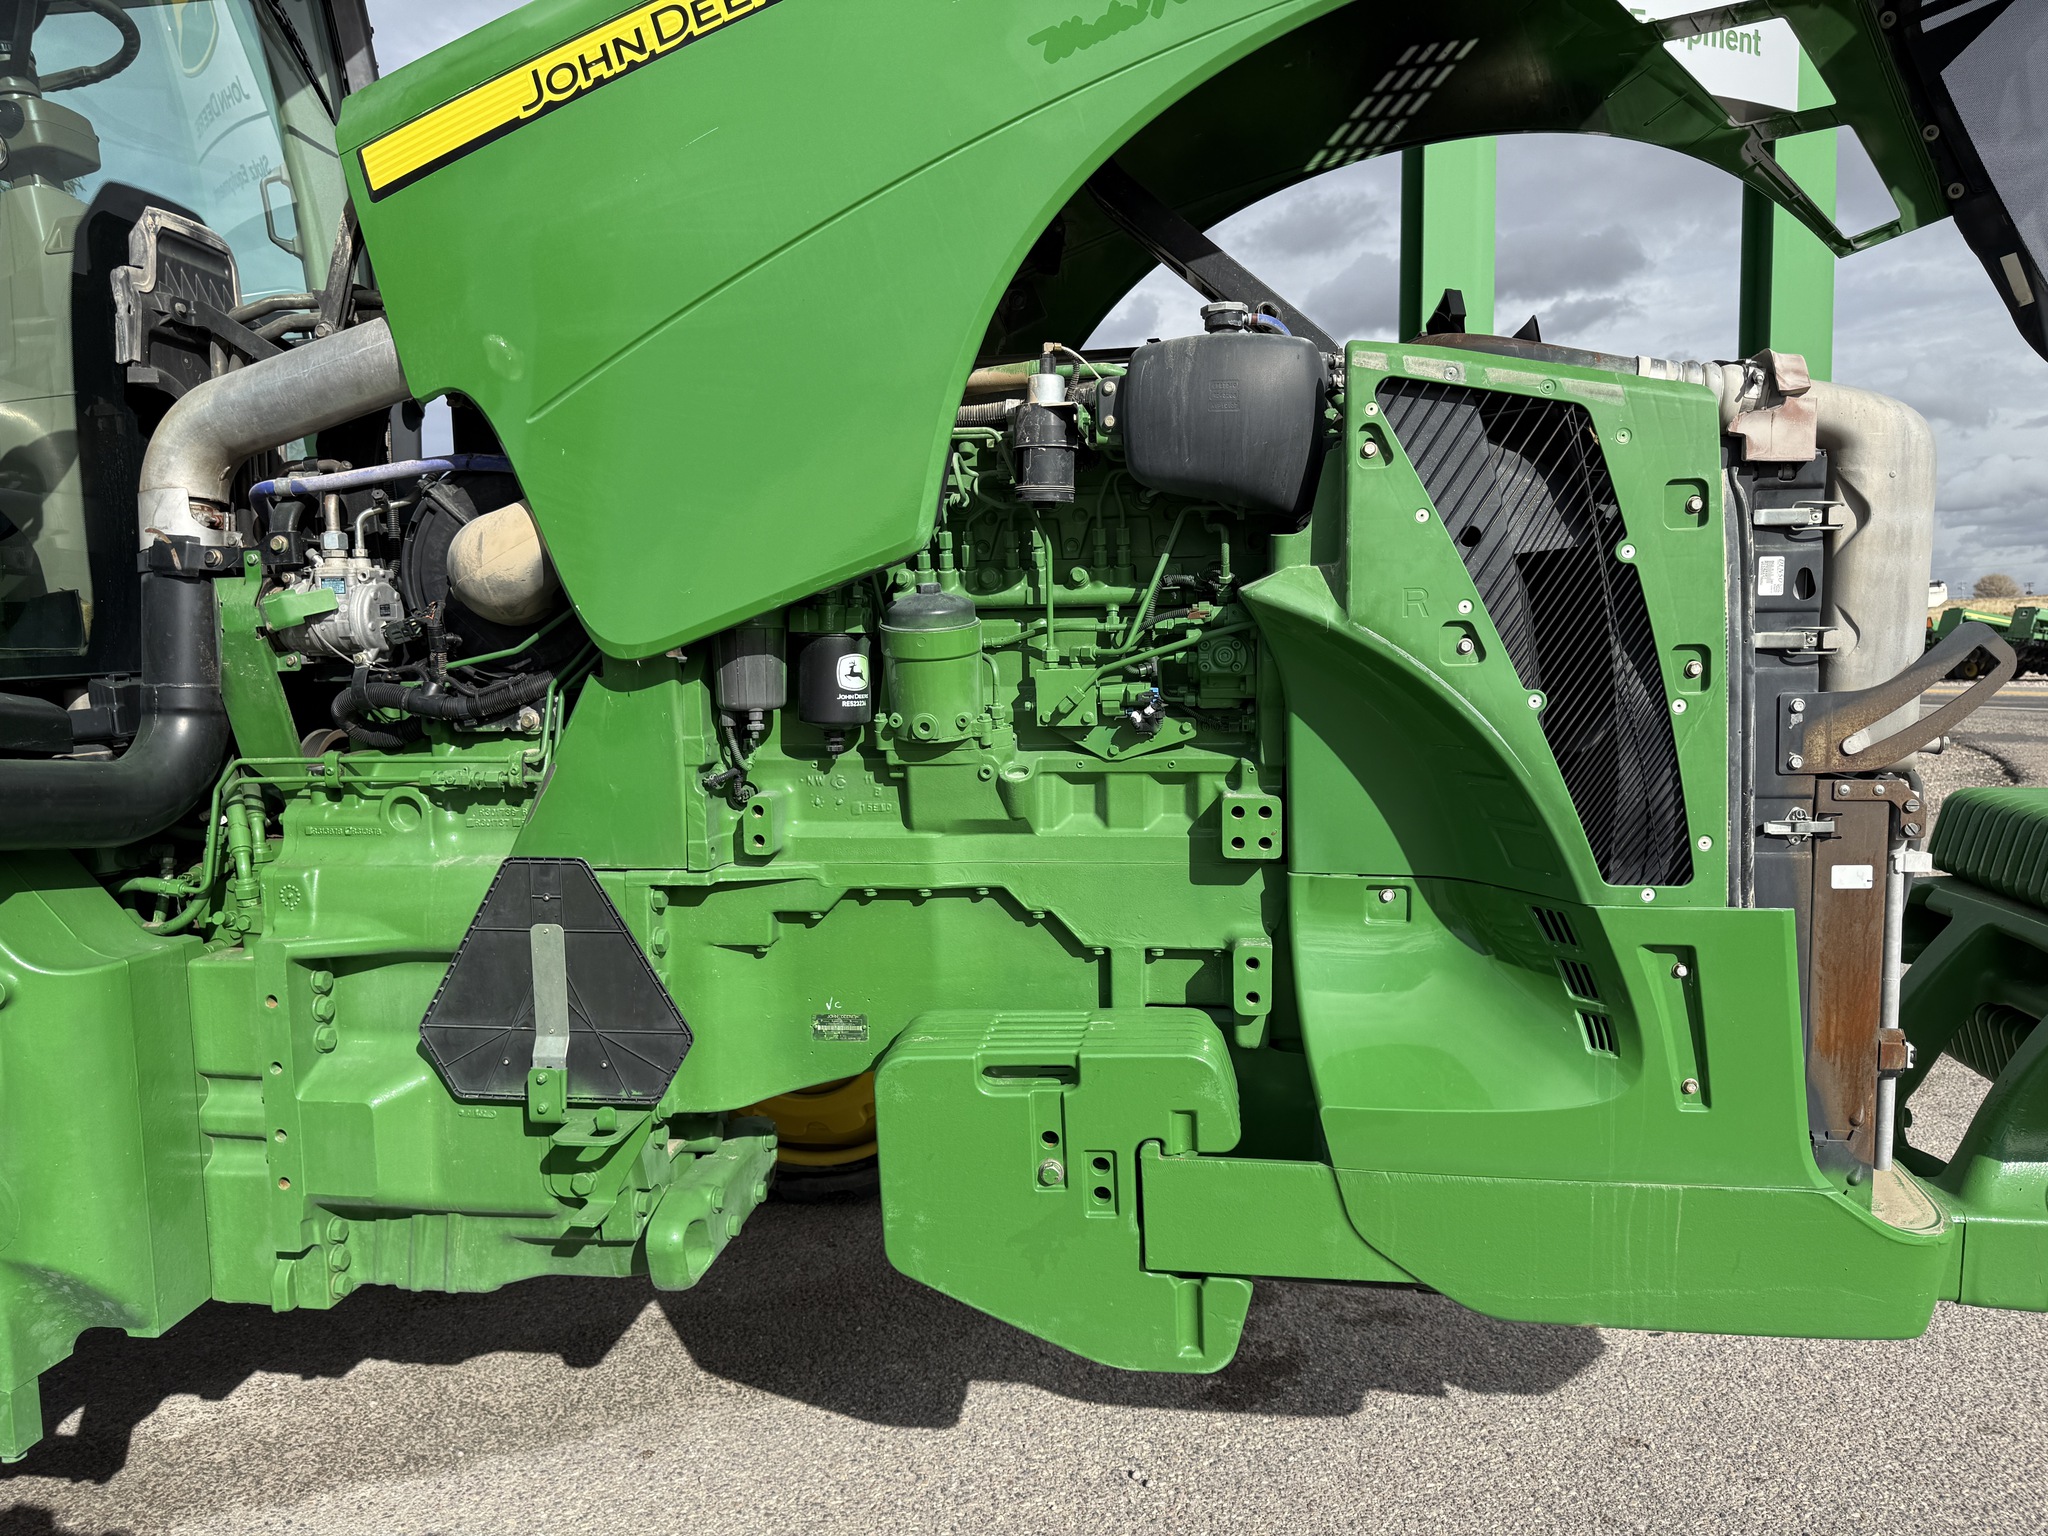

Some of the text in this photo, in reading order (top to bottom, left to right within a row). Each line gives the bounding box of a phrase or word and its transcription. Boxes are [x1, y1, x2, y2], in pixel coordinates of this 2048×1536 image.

[521, 0, 756, 114] JOHN DEE
[1402, 585, 1430, 619] R
